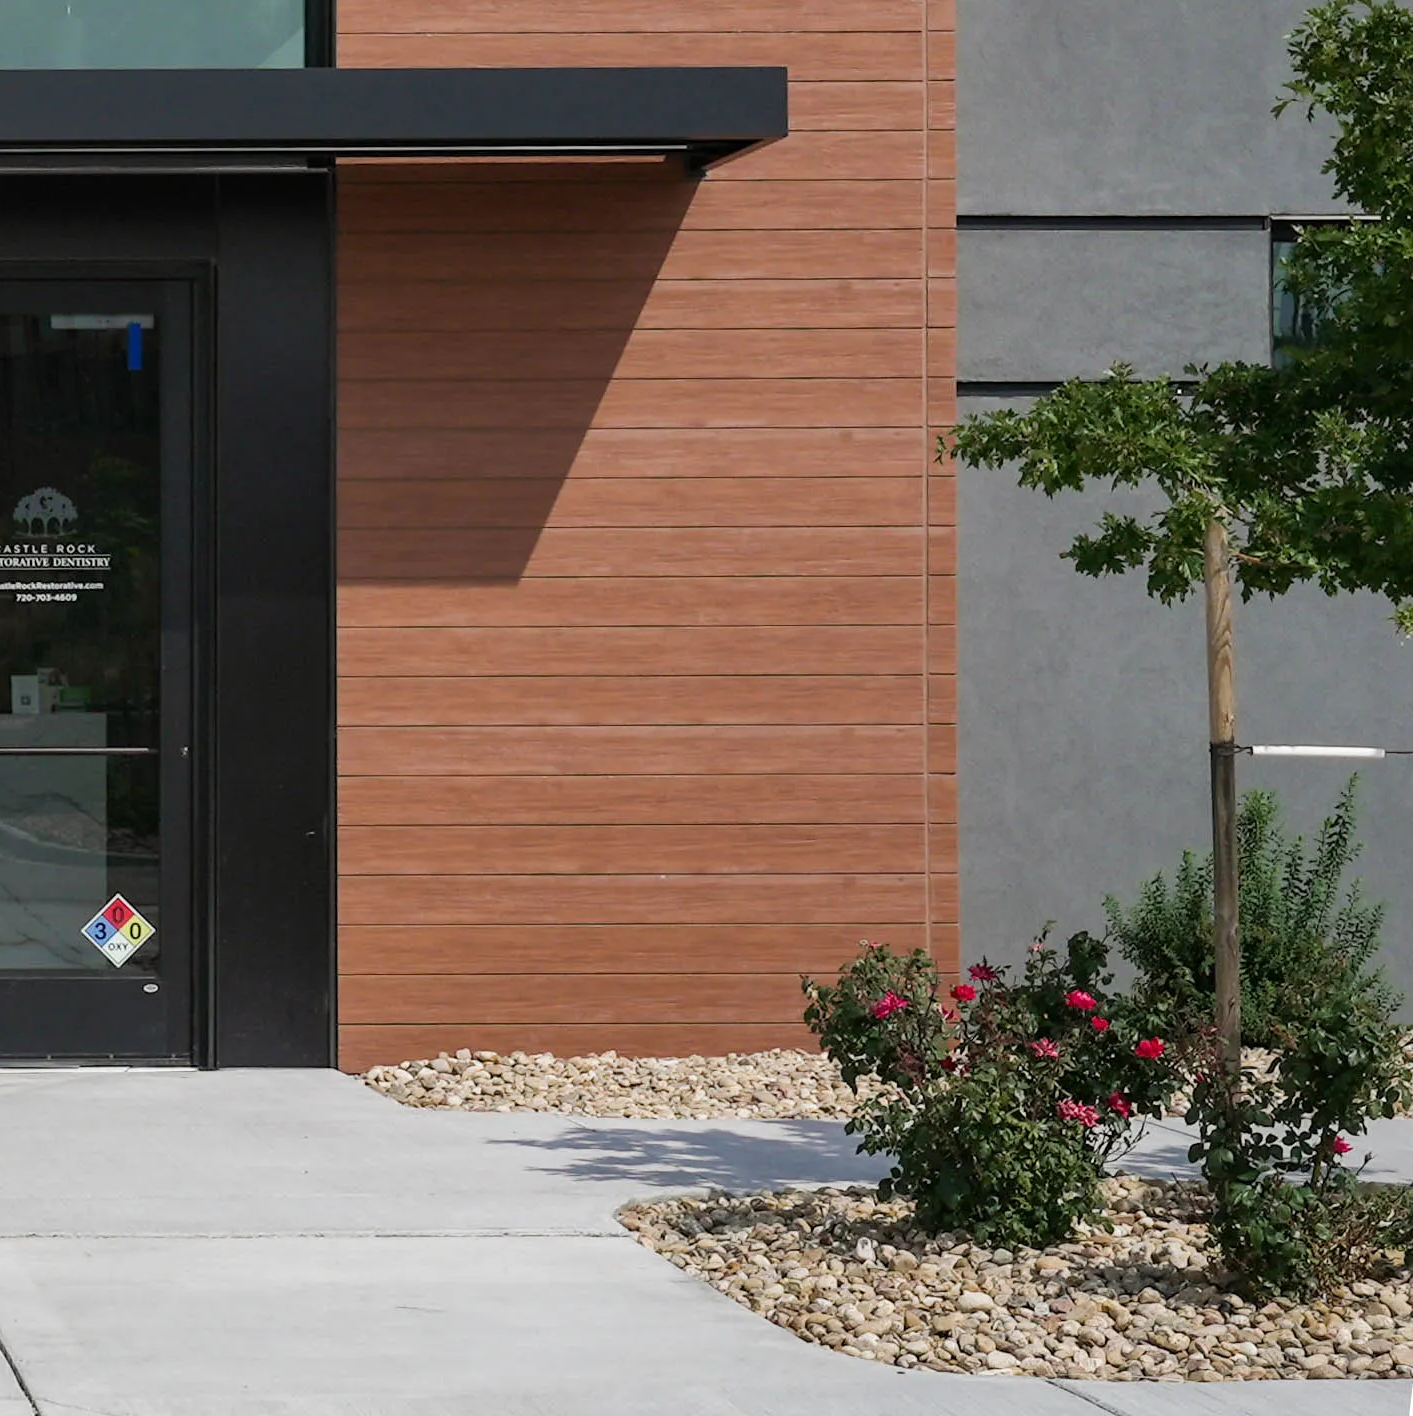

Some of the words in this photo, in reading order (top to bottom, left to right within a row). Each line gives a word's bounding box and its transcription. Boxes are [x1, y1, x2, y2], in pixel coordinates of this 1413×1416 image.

[56, 543, 96, 554] ROCK
[53, 557, 111, 568] DENTISTRY
[112, 906, 125, 923] 0
[94, 922, 107, 940] 3
[129, 922, 142, 940] 0
[107, 942, 129, 951] OXY
